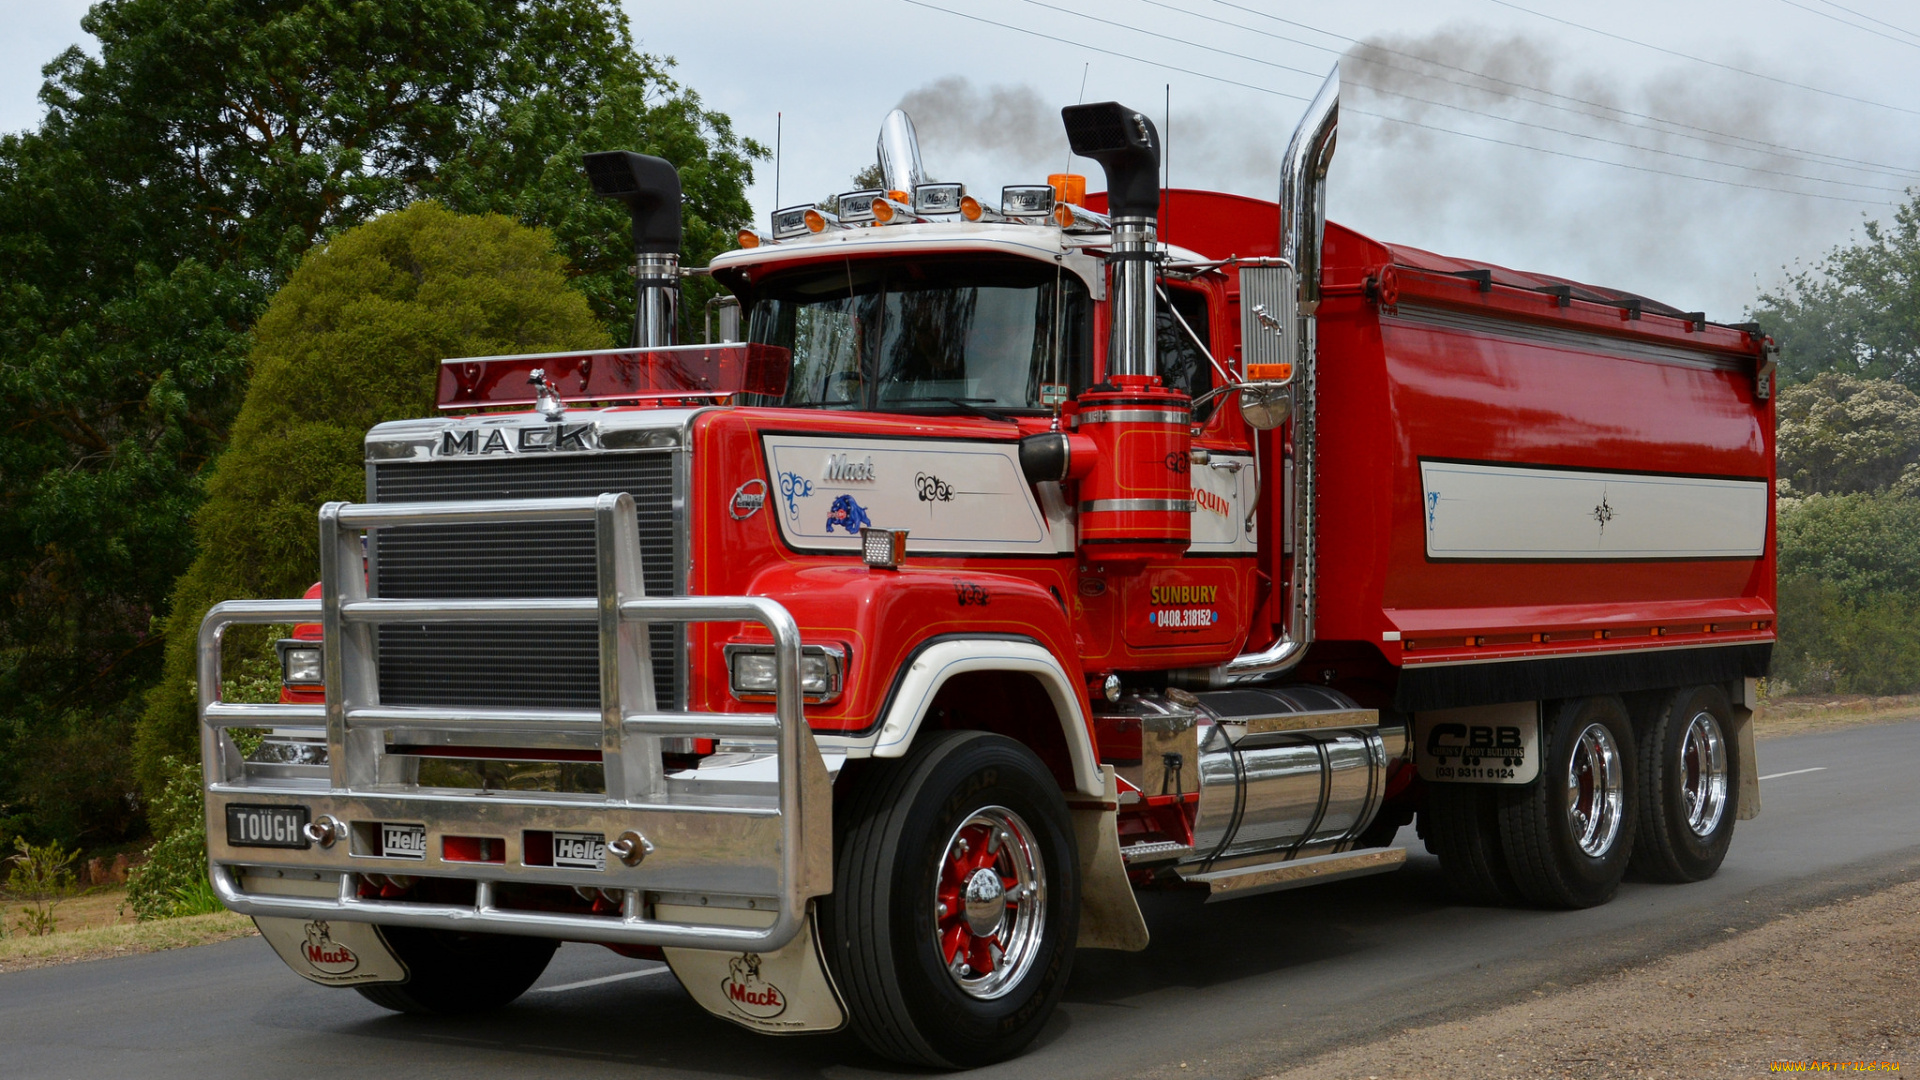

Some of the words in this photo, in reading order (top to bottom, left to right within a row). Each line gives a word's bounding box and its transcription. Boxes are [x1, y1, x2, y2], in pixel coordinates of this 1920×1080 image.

[848, 198, 871, 211] Mack
[924, 191, 949, 204] Mack
[1013, 193, 1038, 206] Mack
[442, 424, 598, 455] MACK
[823, 453, 876, 482] Mack
[1151, 585, 1217, 605] SUNBURY
[1157, 608, 1212, 628] 0408.318152
[1427, 723, 1522, 757] CBB
[1466, 748, 1485, 757] BODY
[1487, 748, 1525, 758] BUILDERS
[1435, 767, 1455, 779] (03)
[1458, 768, 1484, 779] 9311
[1487, 768, 1515, 779] 6124
[237, 813, 298, 842] TOUGH
[559, 839, 606, 860] Hella
[308, 946, 354, 963] Mack
[730, 983, 782, 1006] Mack
